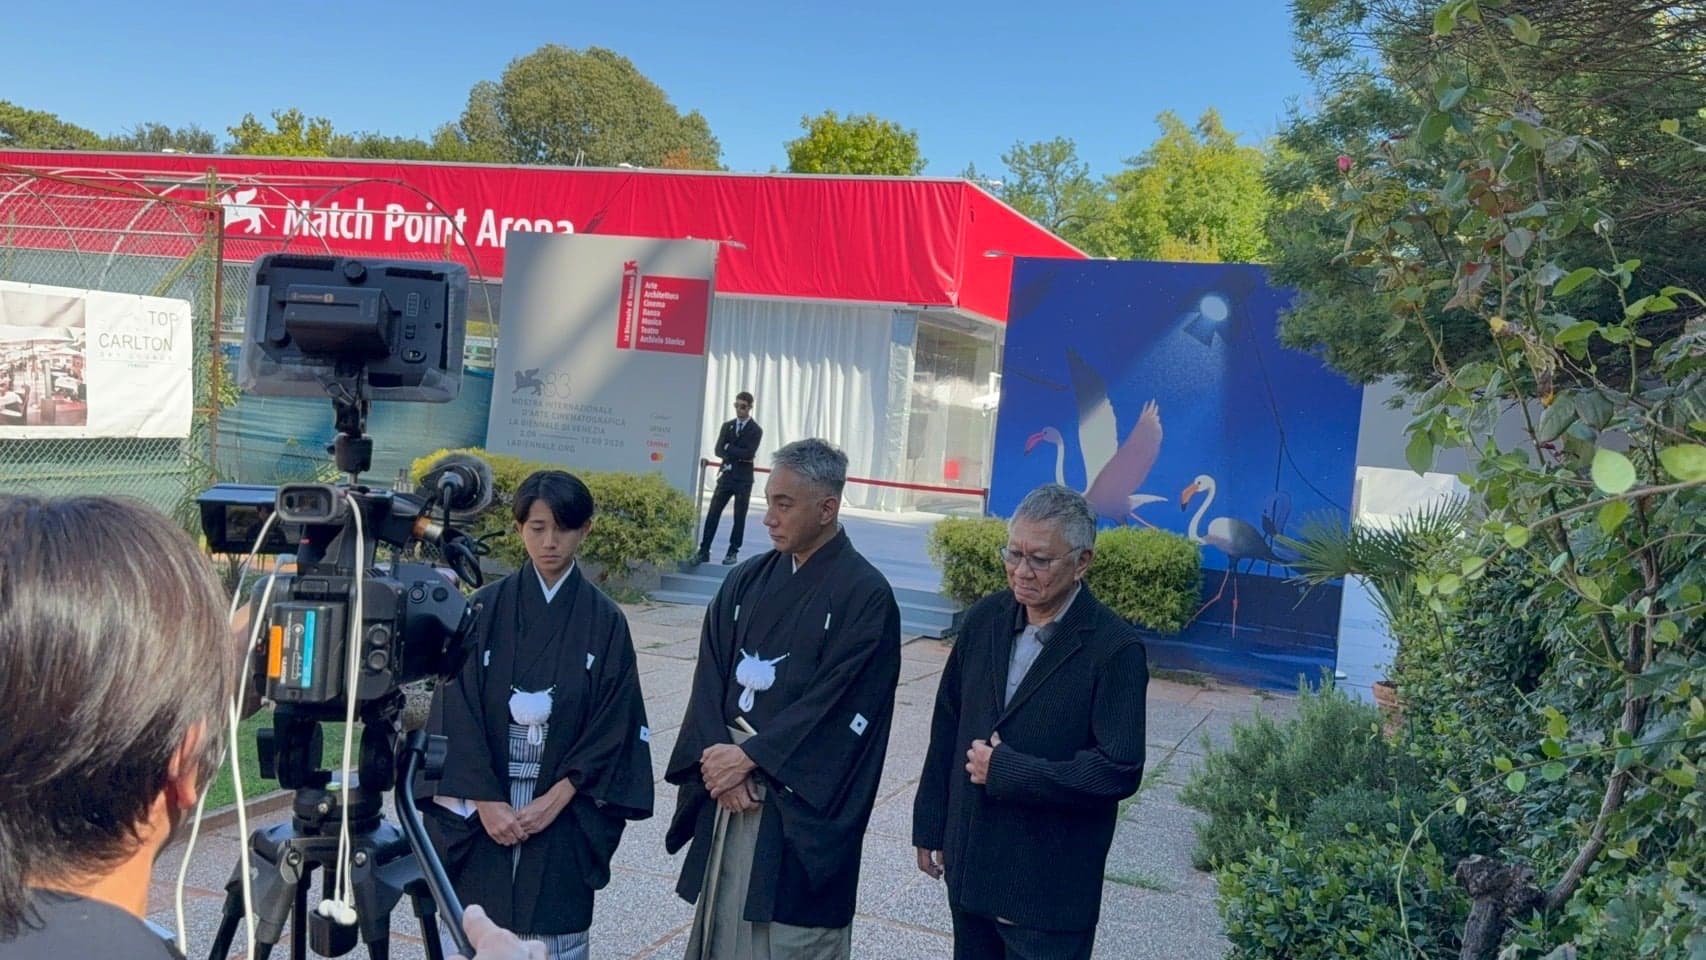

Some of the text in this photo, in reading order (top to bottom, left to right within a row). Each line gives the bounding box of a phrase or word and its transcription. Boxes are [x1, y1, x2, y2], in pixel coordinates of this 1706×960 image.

[283, 197, 373, 240] Match
[384, 203, 467, 246] Point
[645, 282, 658, 290] Arte
[644, 291, 679, 300] Architettura
[643, 300, 666, 308] Cinema
[147, 311, 179, 326] TOP
[641, 318, 662, 326] Musica
[640, 327, 659, 335] Teatro
[98, 333, 172, 351] CARLTON
[511, 397, 613, 414] MOSTRA INTERNAZIONALE
